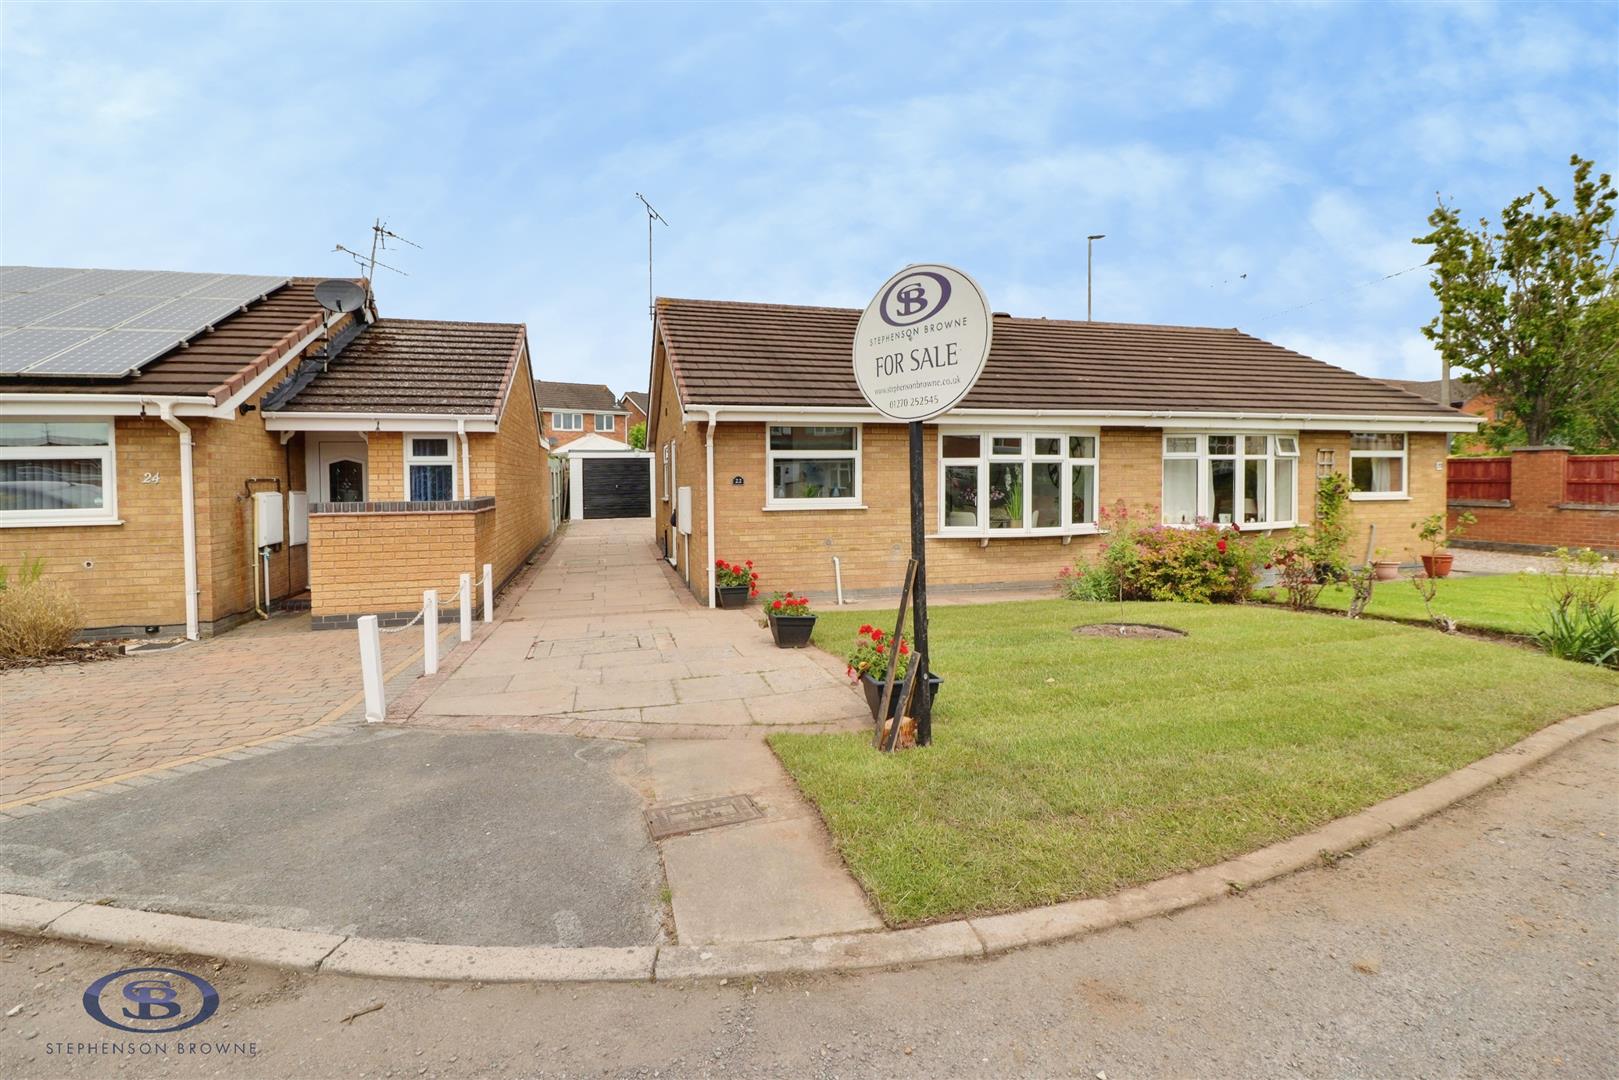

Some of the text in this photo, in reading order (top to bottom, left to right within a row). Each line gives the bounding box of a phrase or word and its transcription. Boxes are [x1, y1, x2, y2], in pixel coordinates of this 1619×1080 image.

[869, 317, 968, 347] STEPHENSON BROWNE
[876, 342, 958, 377] FOR SALE
[874, 375, 961, 395] www.stephensonbrowne.co.uk
[889, 395, 939, 409] 01270 252545
[142, 472, 160, 484] 24
